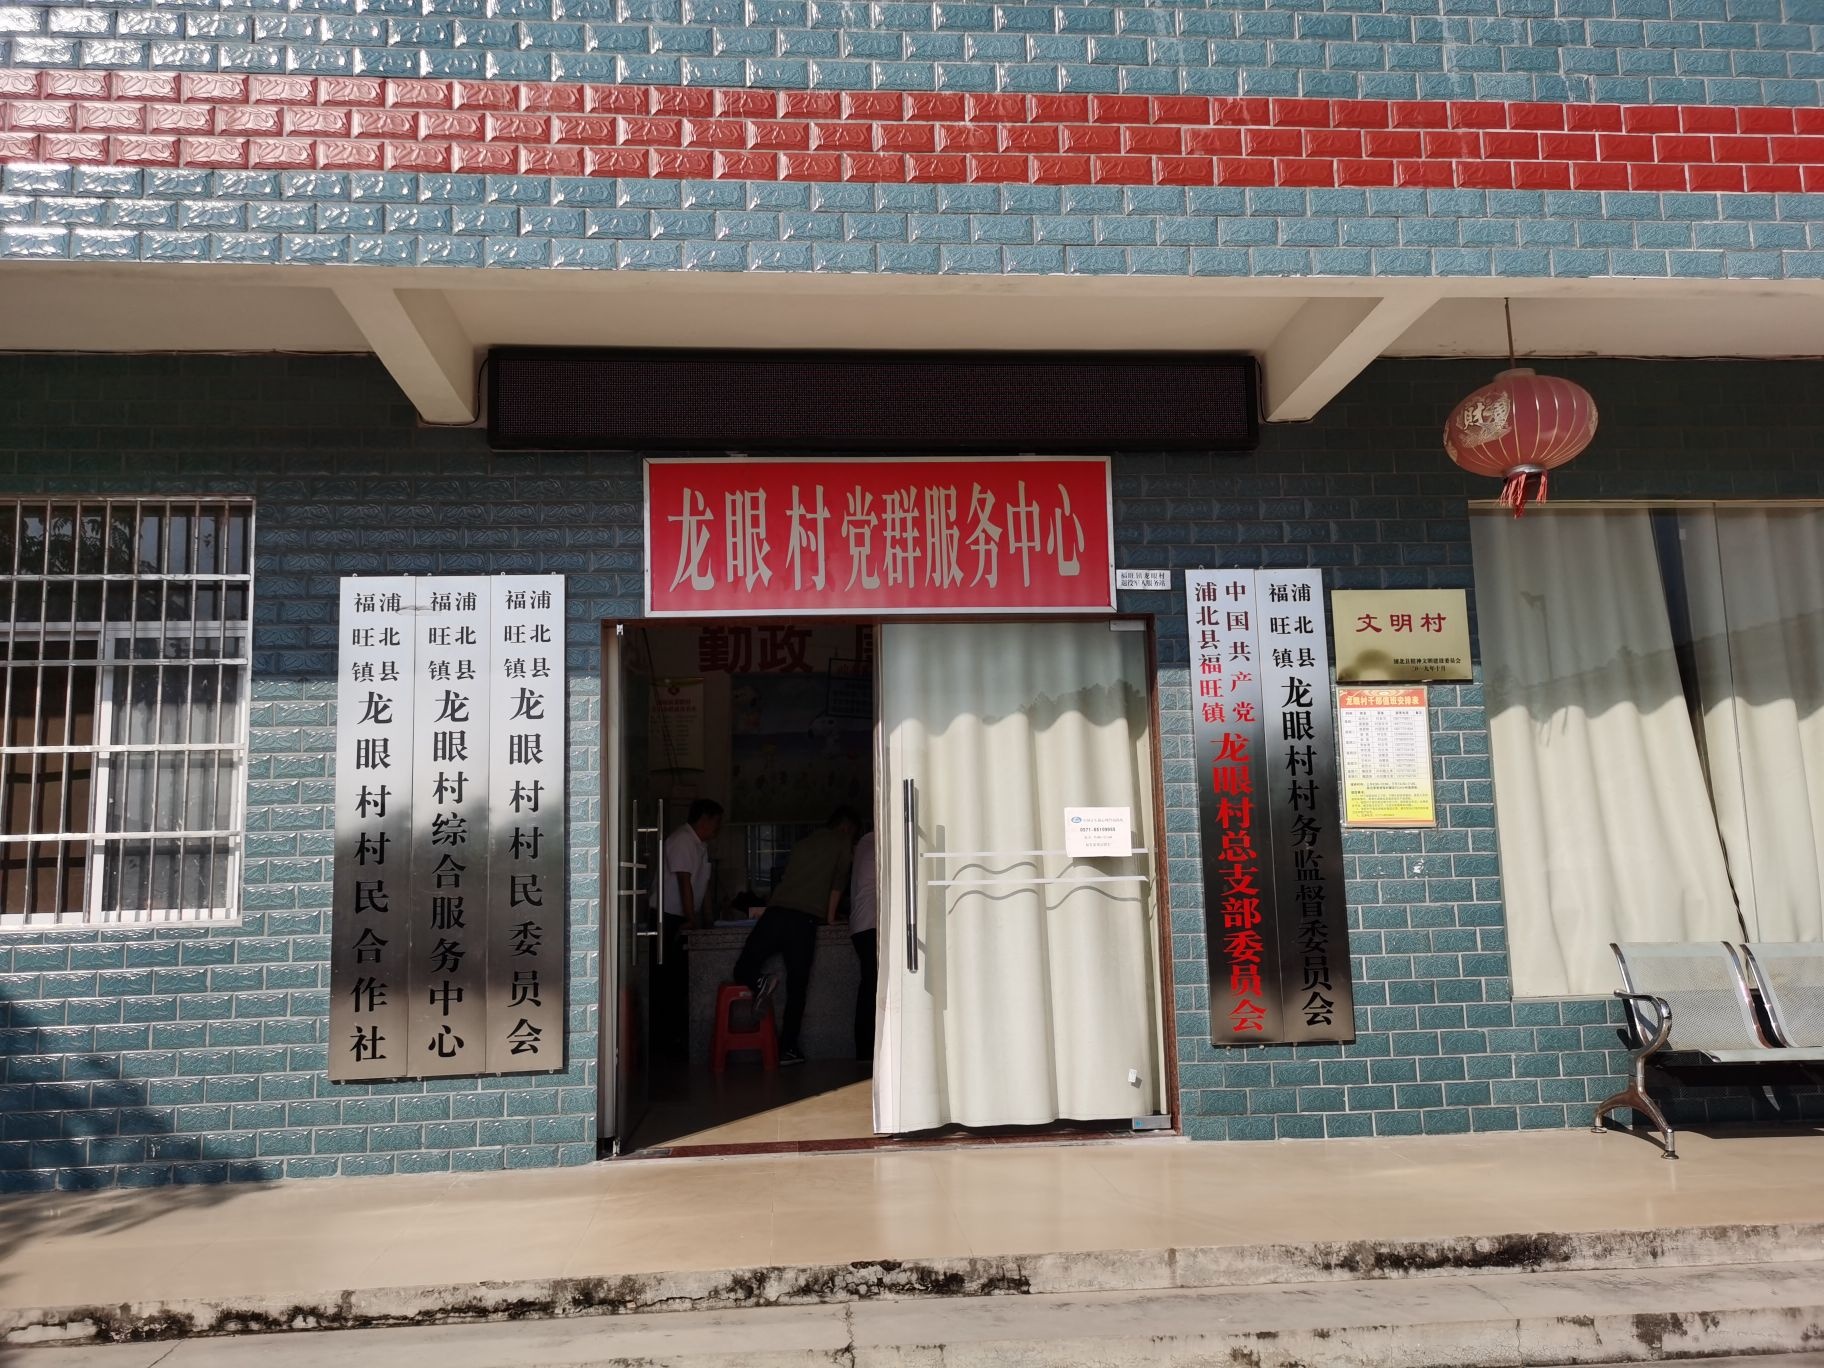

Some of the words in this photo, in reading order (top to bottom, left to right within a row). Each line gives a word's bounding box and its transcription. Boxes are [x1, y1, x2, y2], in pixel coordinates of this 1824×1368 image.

[667, 480, 1085, 593] 龙眼村党群服务中心
[351, 592, 376, 683] 福旺镇
[378, 591, 402, 683] 浦北县
[428, 591, 452, 682] 福旺镇
[454, 591, 478, 681] 浦北县
[503, 589, 528, 680] 福旺镇
[529, 589, 552, 679] 浦北县
[698, 625, 813, 674] 勤政
[1195, 582, 1225, 723] 浦北县福旺镇
[1225, 581, 1256, 723] 中国共产党
[1269, 584, 1294, 669] 福旺镇
[1291, 584, 1316, 667] 浦北县
[1355, 612, 1447, 633] 文明村
[349, 691, 393, 1062] 龙眼村村民合作社
[428, 690, 470, 1059] 龙眼村综合服务中心
[506, 687, 545, 1056] 龙眼村村民委员会
[1212, 732, 1267, 1032] 龙眼村总支部委员会
[1281, 676, 1335, 1027] 龙眼村村务监督委员会
